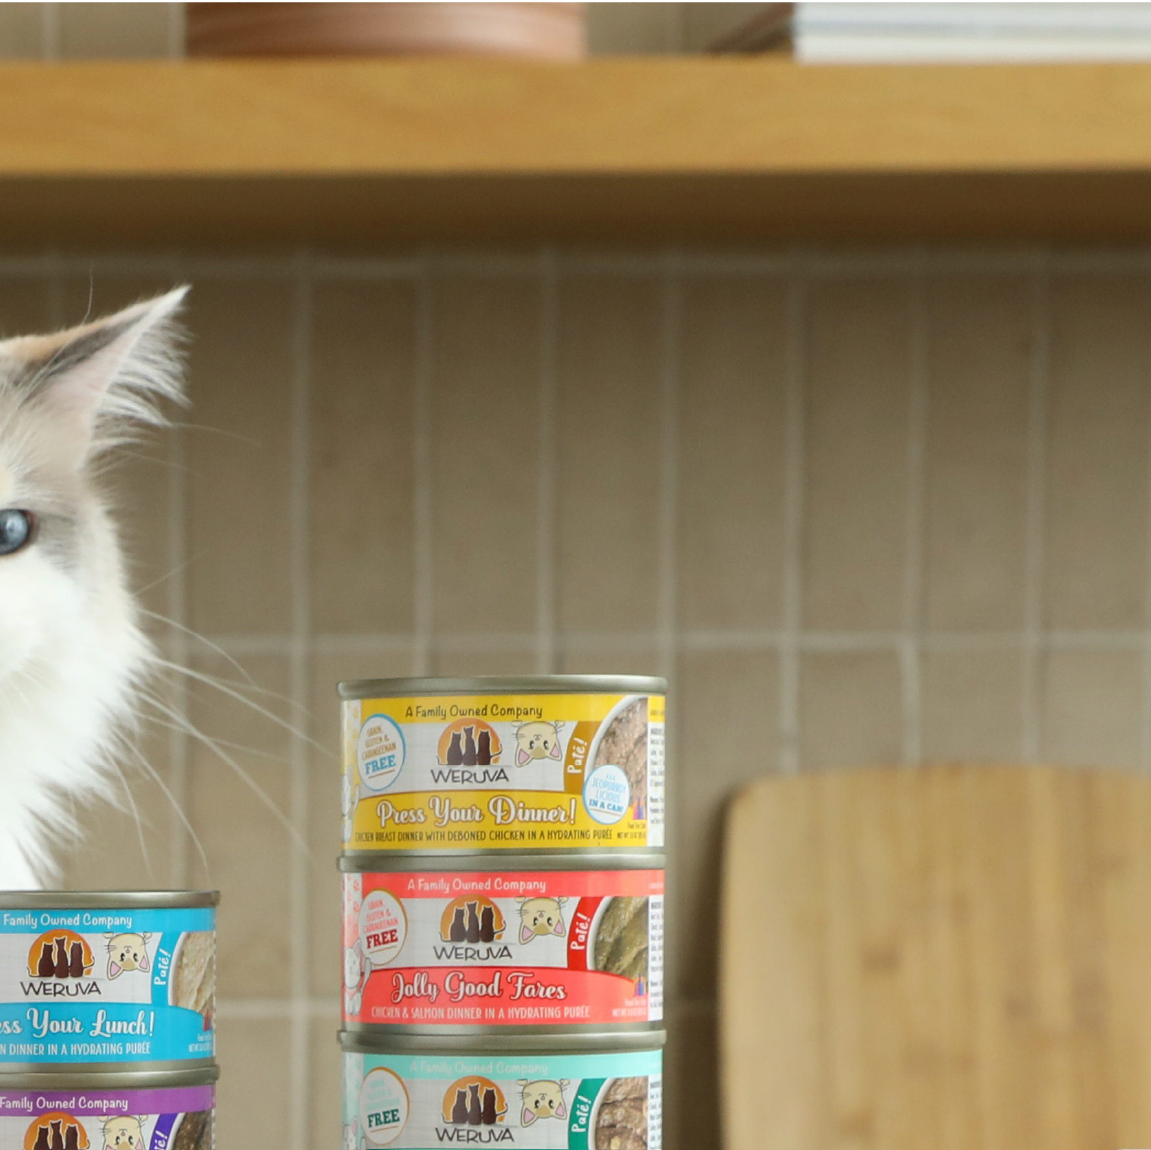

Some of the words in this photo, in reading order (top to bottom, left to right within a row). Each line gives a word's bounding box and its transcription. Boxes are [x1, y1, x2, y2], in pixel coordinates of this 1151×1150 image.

[405, 706, 413, 717] A
[416, 705, 447, 720] Family
[450, 704, 487, 717] Owned
[490, 704, 543, 718] Company
[567, 737, 588, 774] Paté!
[365, 754, 396, 776] FREE
[430, 768, 510, 784] WERUVA
[377, 799, 427, 829] Press
[429, 796, 484, 827] Your
[489, 795, 577, 825] Dinner!
[398, 831, 423, 842] DINNER
[425, 831, 446, 842] WITH
[448, 831, 485, 841] DEBONED
[489, 831, 526, 841] CHICKEN
[548, 830, 590, 840] HYDRATING
[407, 879, 415, 890] A
[418, 879, 450, 894] Family
[452, 878, 491, 890] Owned
[494, 878, 547, 894] Company
[3, 914, 37, 929] Family
[40, 914, 80, 926] Owned
[83, 913, 132, 929] Company
[366, 929, 399, 949] FREE
[570, 912, 592, 950] Paté!
[433, 945, 512, 961] WERUVA
[154, 948, 172, 985] Paté!
[20, 981, 101, 997] WERUVA
[391, 972, 438, 1004] Jolly
[444, 970, 502, 1003] Good
[507, 972, 566, 1000] Fares
[372, 1006, 400, 1018] CHICKEN
[411, 1007, 443, 1019] SALMON
[447, 1008, 481, 1019] DINNER
[485, 1008, 495, 1019] IN
[508, 1007, 562, 1019] HYDRATING
[26, 1007, 84, 1039] Your
[90, 1009, 156, 1038] Lunch!
[9, 1043, 45, 1055] DINNER
[48, 1044, 58, 1055] IN
[70, 1043, 123, 1055] HYDRATING
[0, 1097, 33, 1112] Family
[36, 1097, 75, 1109] Owned
[79, 1097, 128, 1112] Company
[367, 1108, 400, 1128] FREE
[571, 1095, 592, 1133] Paté!
[435, 1127, 514, 1144] WERUVA
